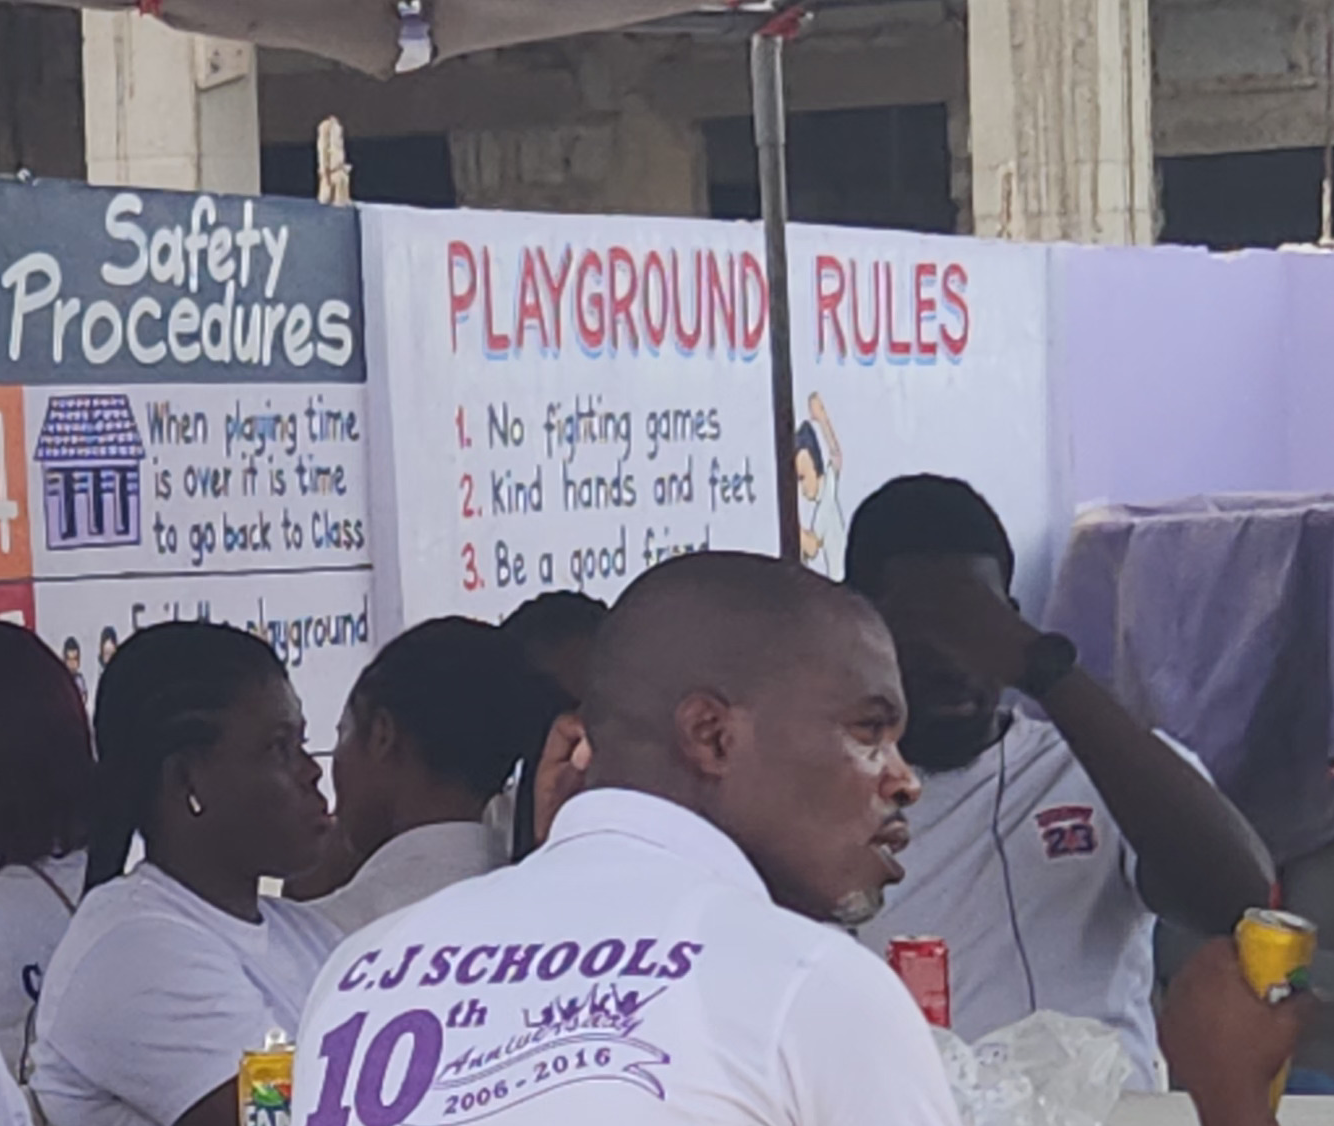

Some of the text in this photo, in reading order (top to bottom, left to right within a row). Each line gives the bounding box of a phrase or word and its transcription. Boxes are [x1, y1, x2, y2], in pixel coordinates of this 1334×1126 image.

[100, 192, 290, 289] Safety
[1, 251, 354, 366] Procedures
[447, 240, 970, 360] PLAYGROUND RULES
[146, 394, 360, 459] When playing time
[455, 394, 722, 463] 1. No fighting games
[152, 451, 348, 501] is over it is time
[459, 472, 483, 519] 2.
[561, 459, 637, 512] hands
[654, 454, 694, 505] and
[708, 456, 757, 513] feet
[153, 507, 366, 567] to go back to Class
[461, 542, 485, 591] 3.
[495, 540, 527, 588] Be
[539, 552, 554, 585] a
[570, 524, 627, 592] good
[418, 937, 705, 988] SCHOOLS
[445, 997, 488, 1029] th
[442, 1078, 510, 1117] 2006
[533, 1047, 612, 1084] 2016
